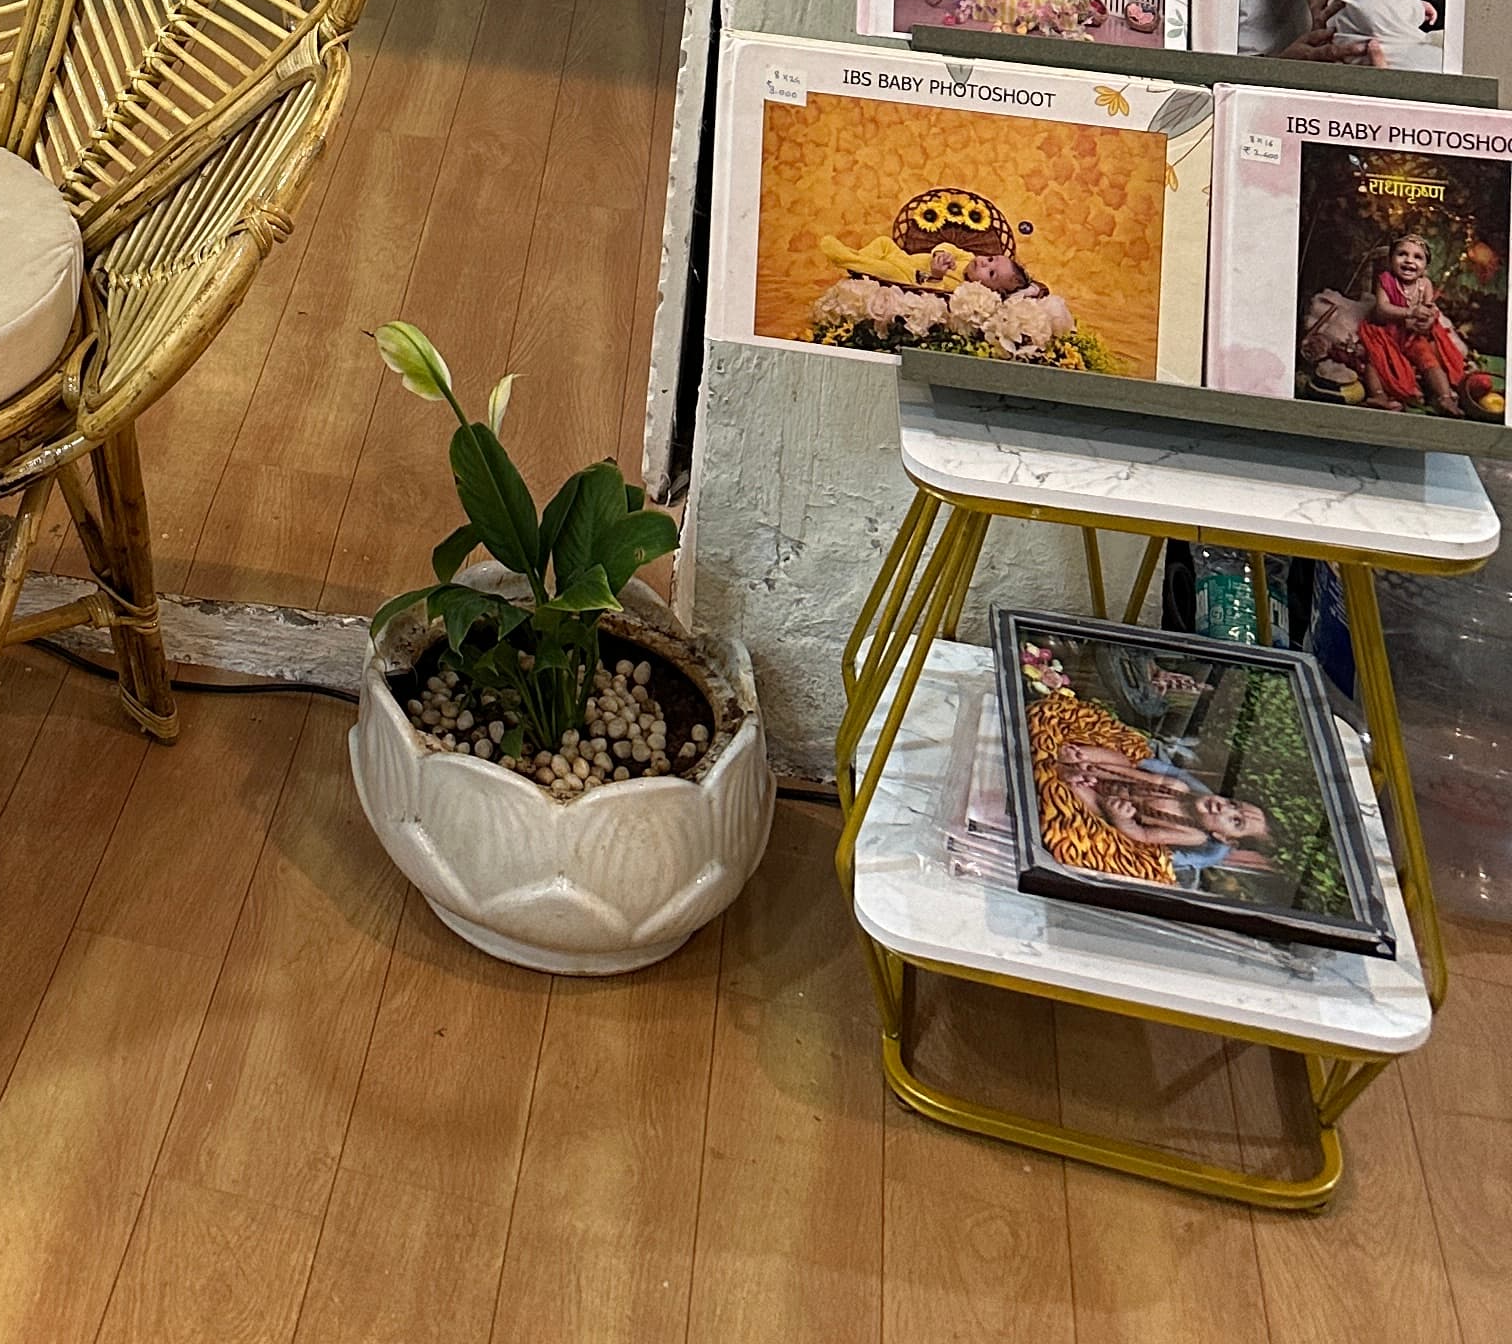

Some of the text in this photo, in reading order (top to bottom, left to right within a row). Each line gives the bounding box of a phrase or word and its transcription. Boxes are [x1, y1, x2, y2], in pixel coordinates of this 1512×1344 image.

[843, 69, 1056, 108] IBS BABY PHOTOSHOOT
[1286, 116, 1512, 154] IBS BABY PHOTOSHO
[1369, 178, 1446, 204] राधाकृष्ण
